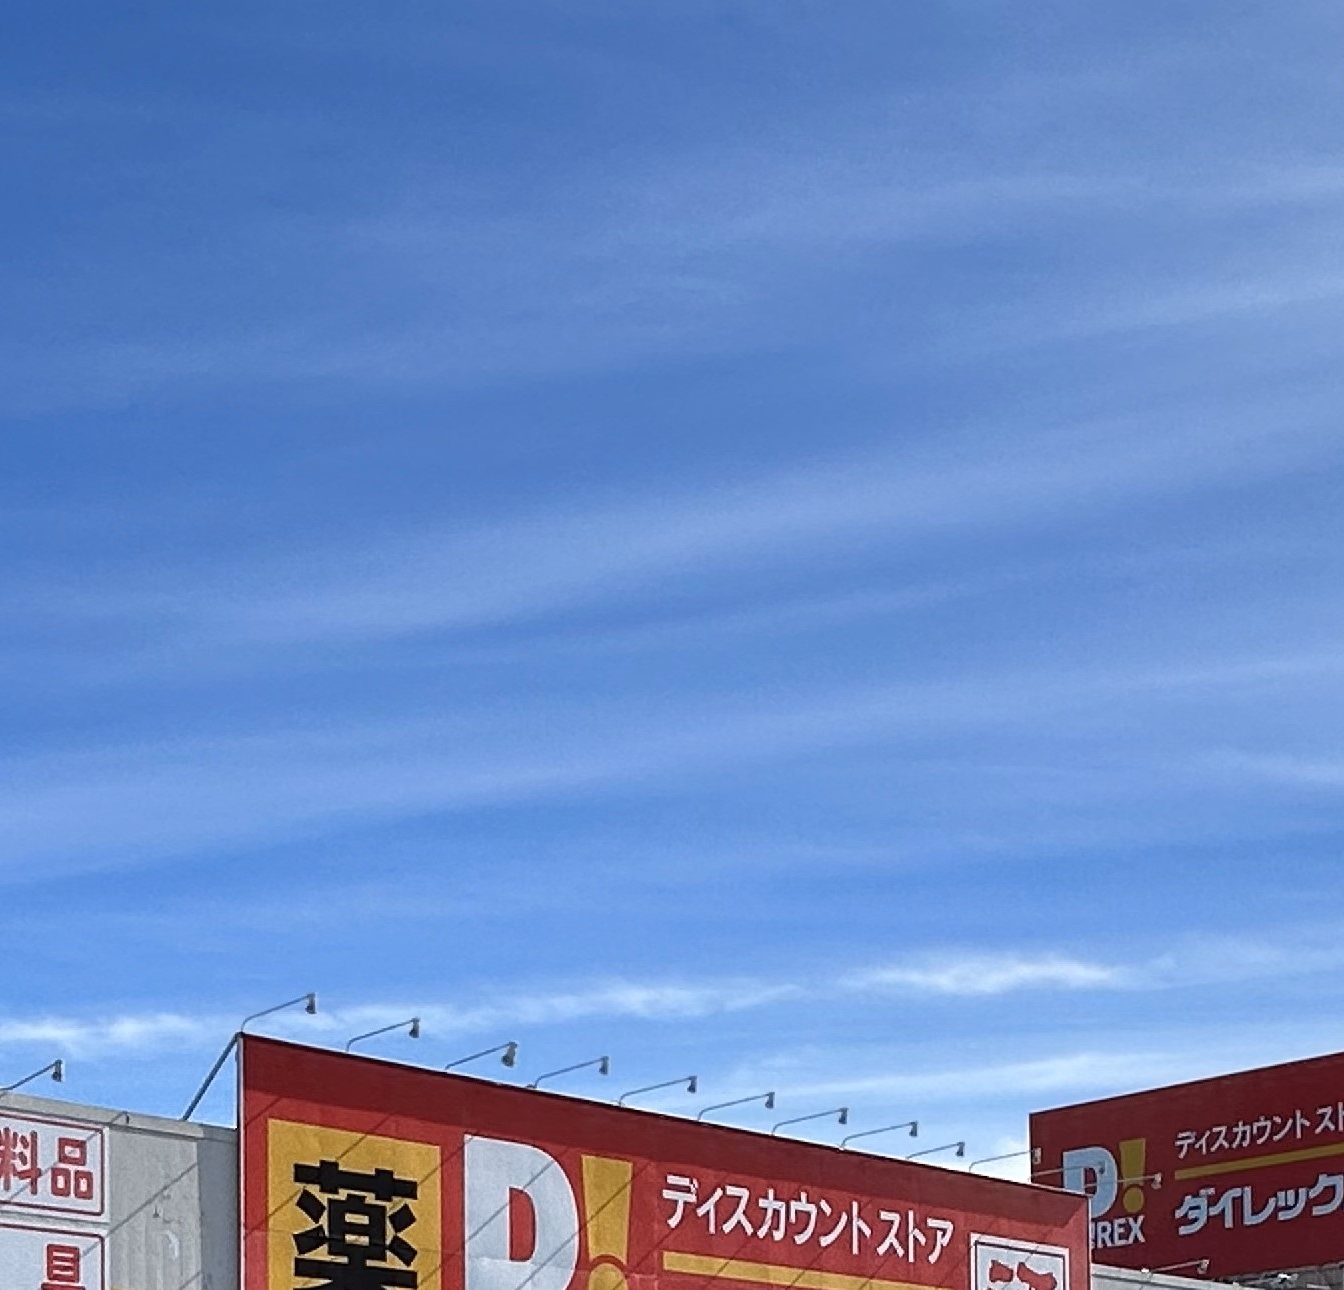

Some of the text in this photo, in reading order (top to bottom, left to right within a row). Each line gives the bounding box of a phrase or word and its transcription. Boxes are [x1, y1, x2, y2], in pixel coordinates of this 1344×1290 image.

[662, 1173, 954, 1264] ディスカウントストア
